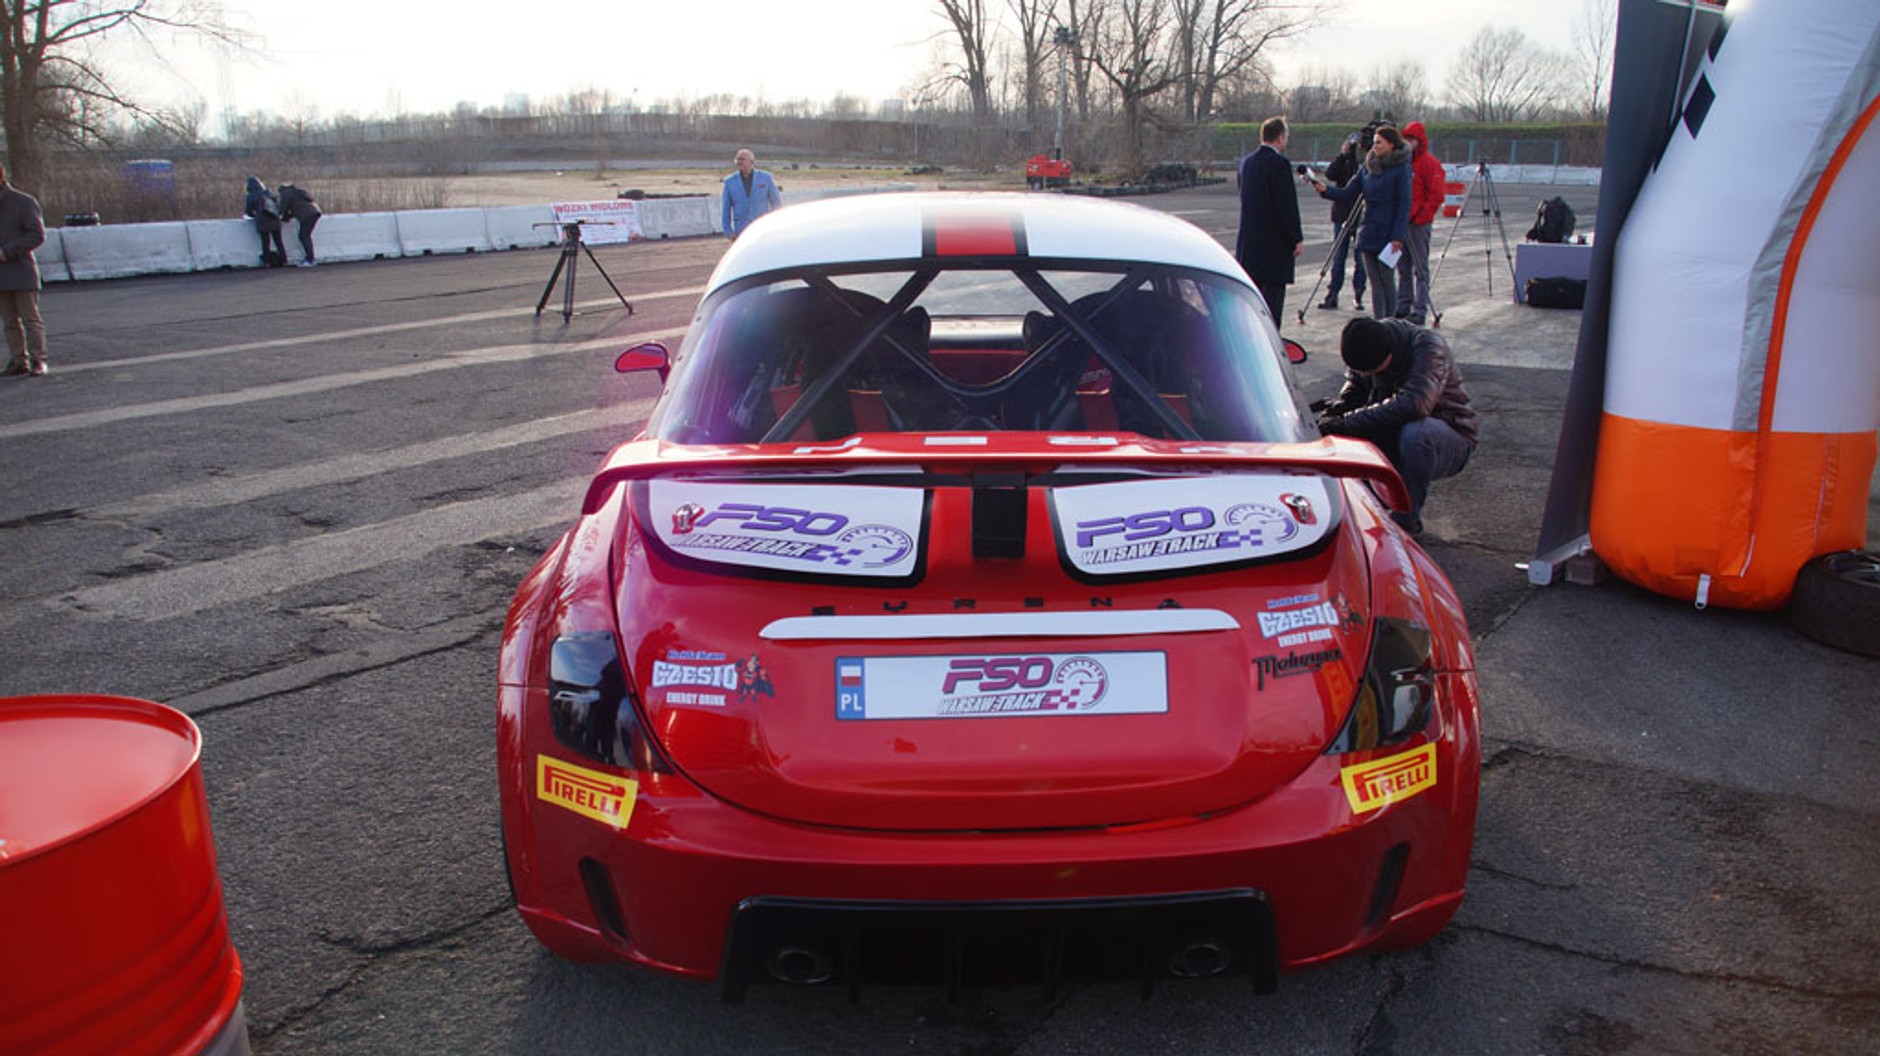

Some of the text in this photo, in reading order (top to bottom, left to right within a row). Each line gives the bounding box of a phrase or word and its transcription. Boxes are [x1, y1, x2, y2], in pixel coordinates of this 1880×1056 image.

[695, 503, 849, 536] FSO
[1076, 506, 1215, 548] FSO
[746, 539, 819, 558] TRACK
[1081, 532, 1222, 564] WARSAW TRACK
[1257, 601, 1339, 639] CZESIO
[652, 660, 738, 690] CZESIO
[942, 657, 1055, 694] FSO
[667, 692, 726, 706] ENERGY DRINK
[840, 693, 863, 711] PL
[940, 692, 1046, 714] WARSAW TRACK
[544, 764, 626, 817] PIRELLI
[1353, 752, 1430, 803] PIRELLI
